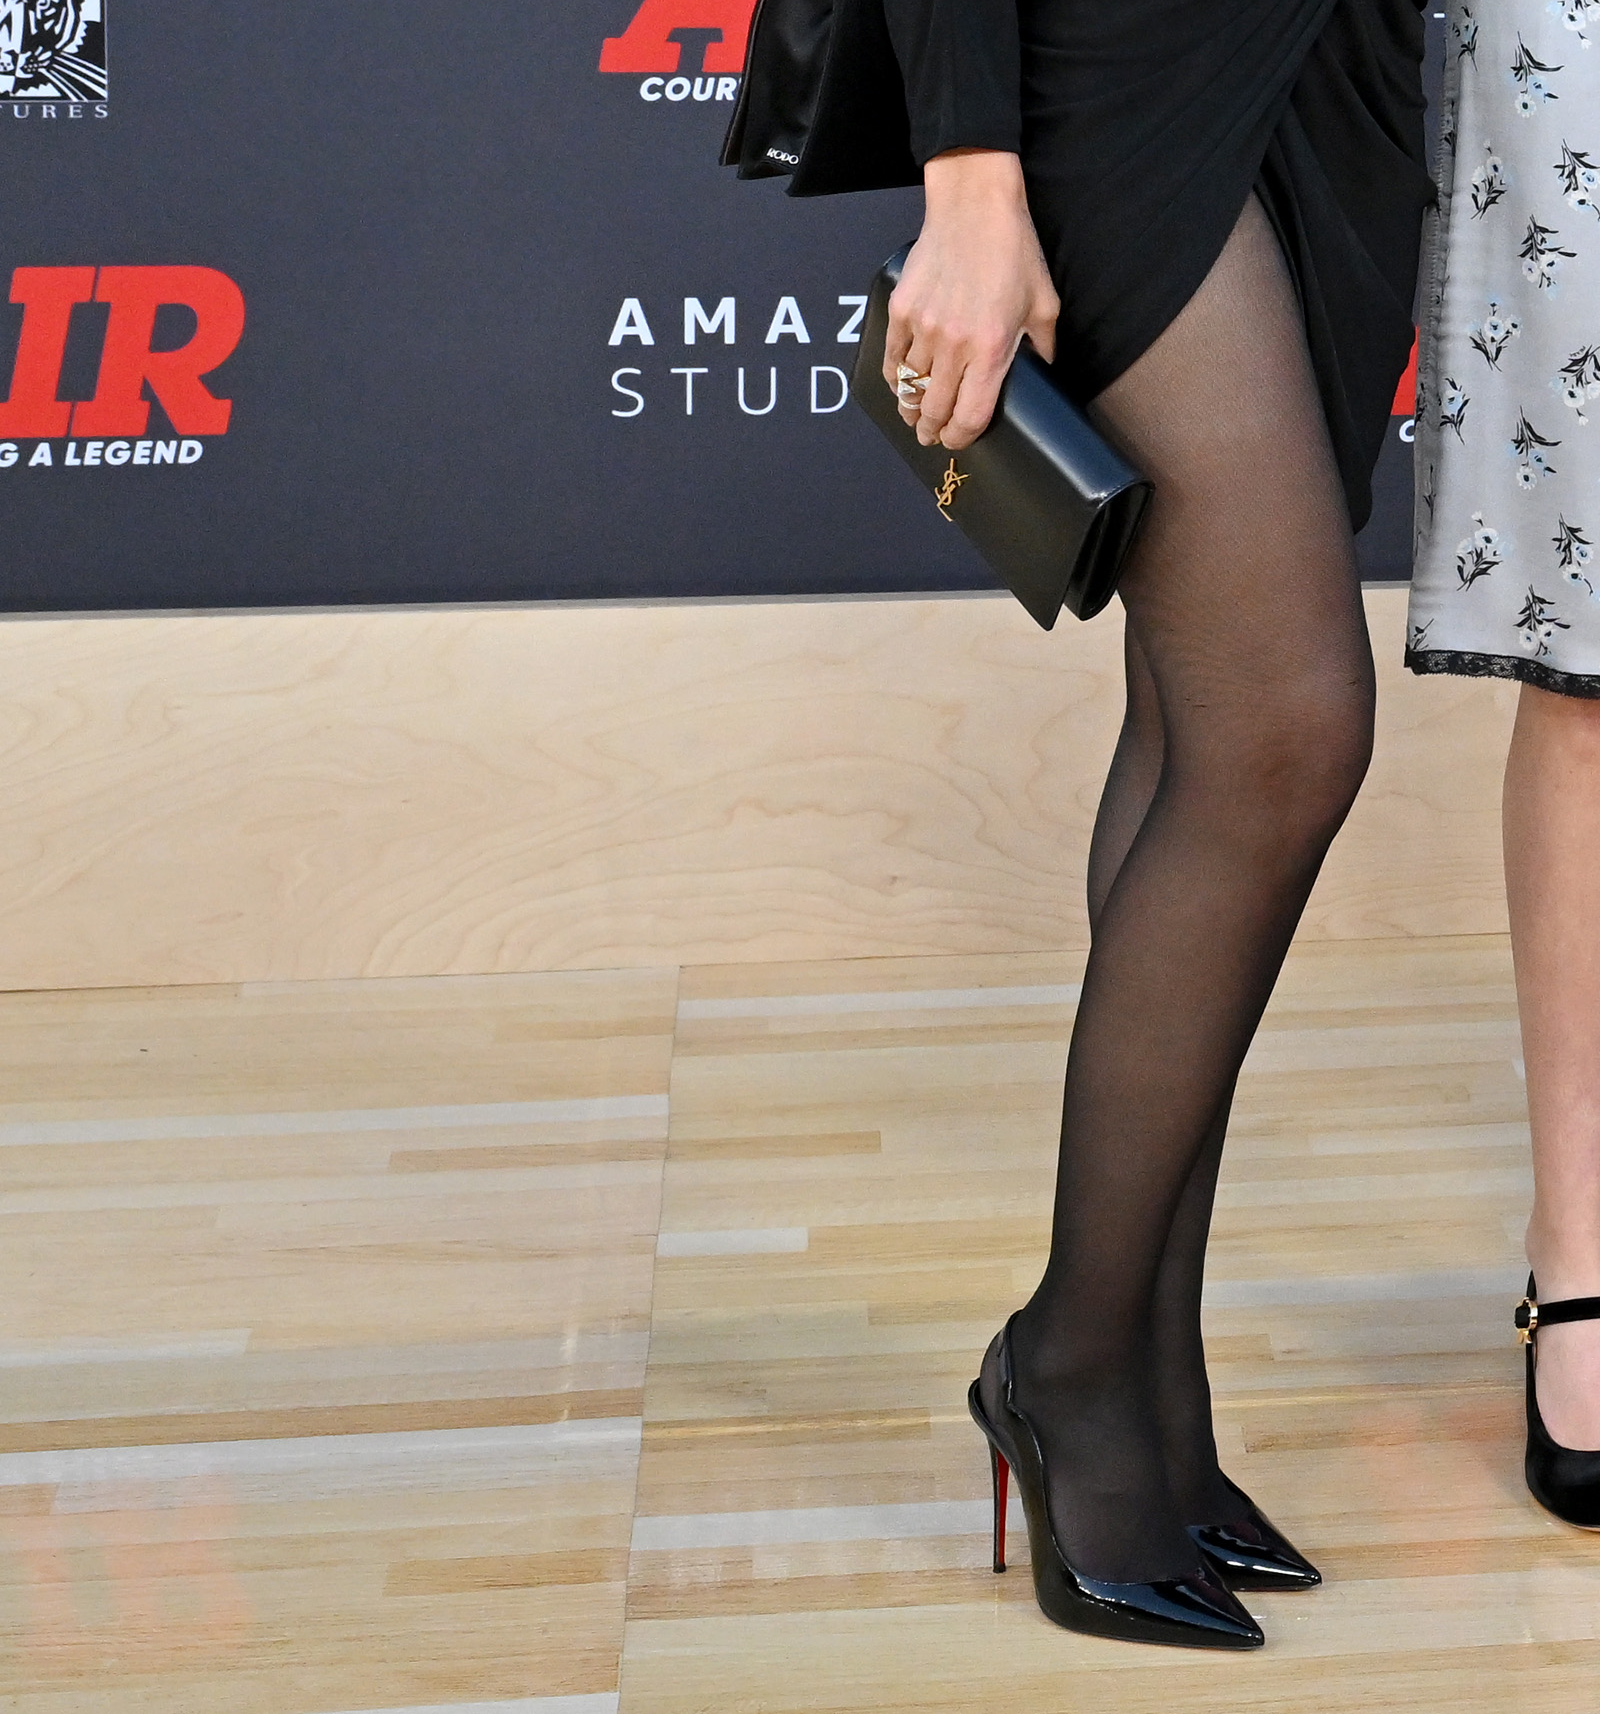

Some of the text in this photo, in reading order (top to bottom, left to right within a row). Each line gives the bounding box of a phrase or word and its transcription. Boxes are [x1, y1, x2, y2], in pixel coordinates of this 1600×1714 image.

[640, 77, 741, 101] COUR
[0, 104, 109, 119] URES
[767, 147, 799, 165] RODO
[29, 443, 52, 466] A
[65, 440, 202, 465] LEGEND
